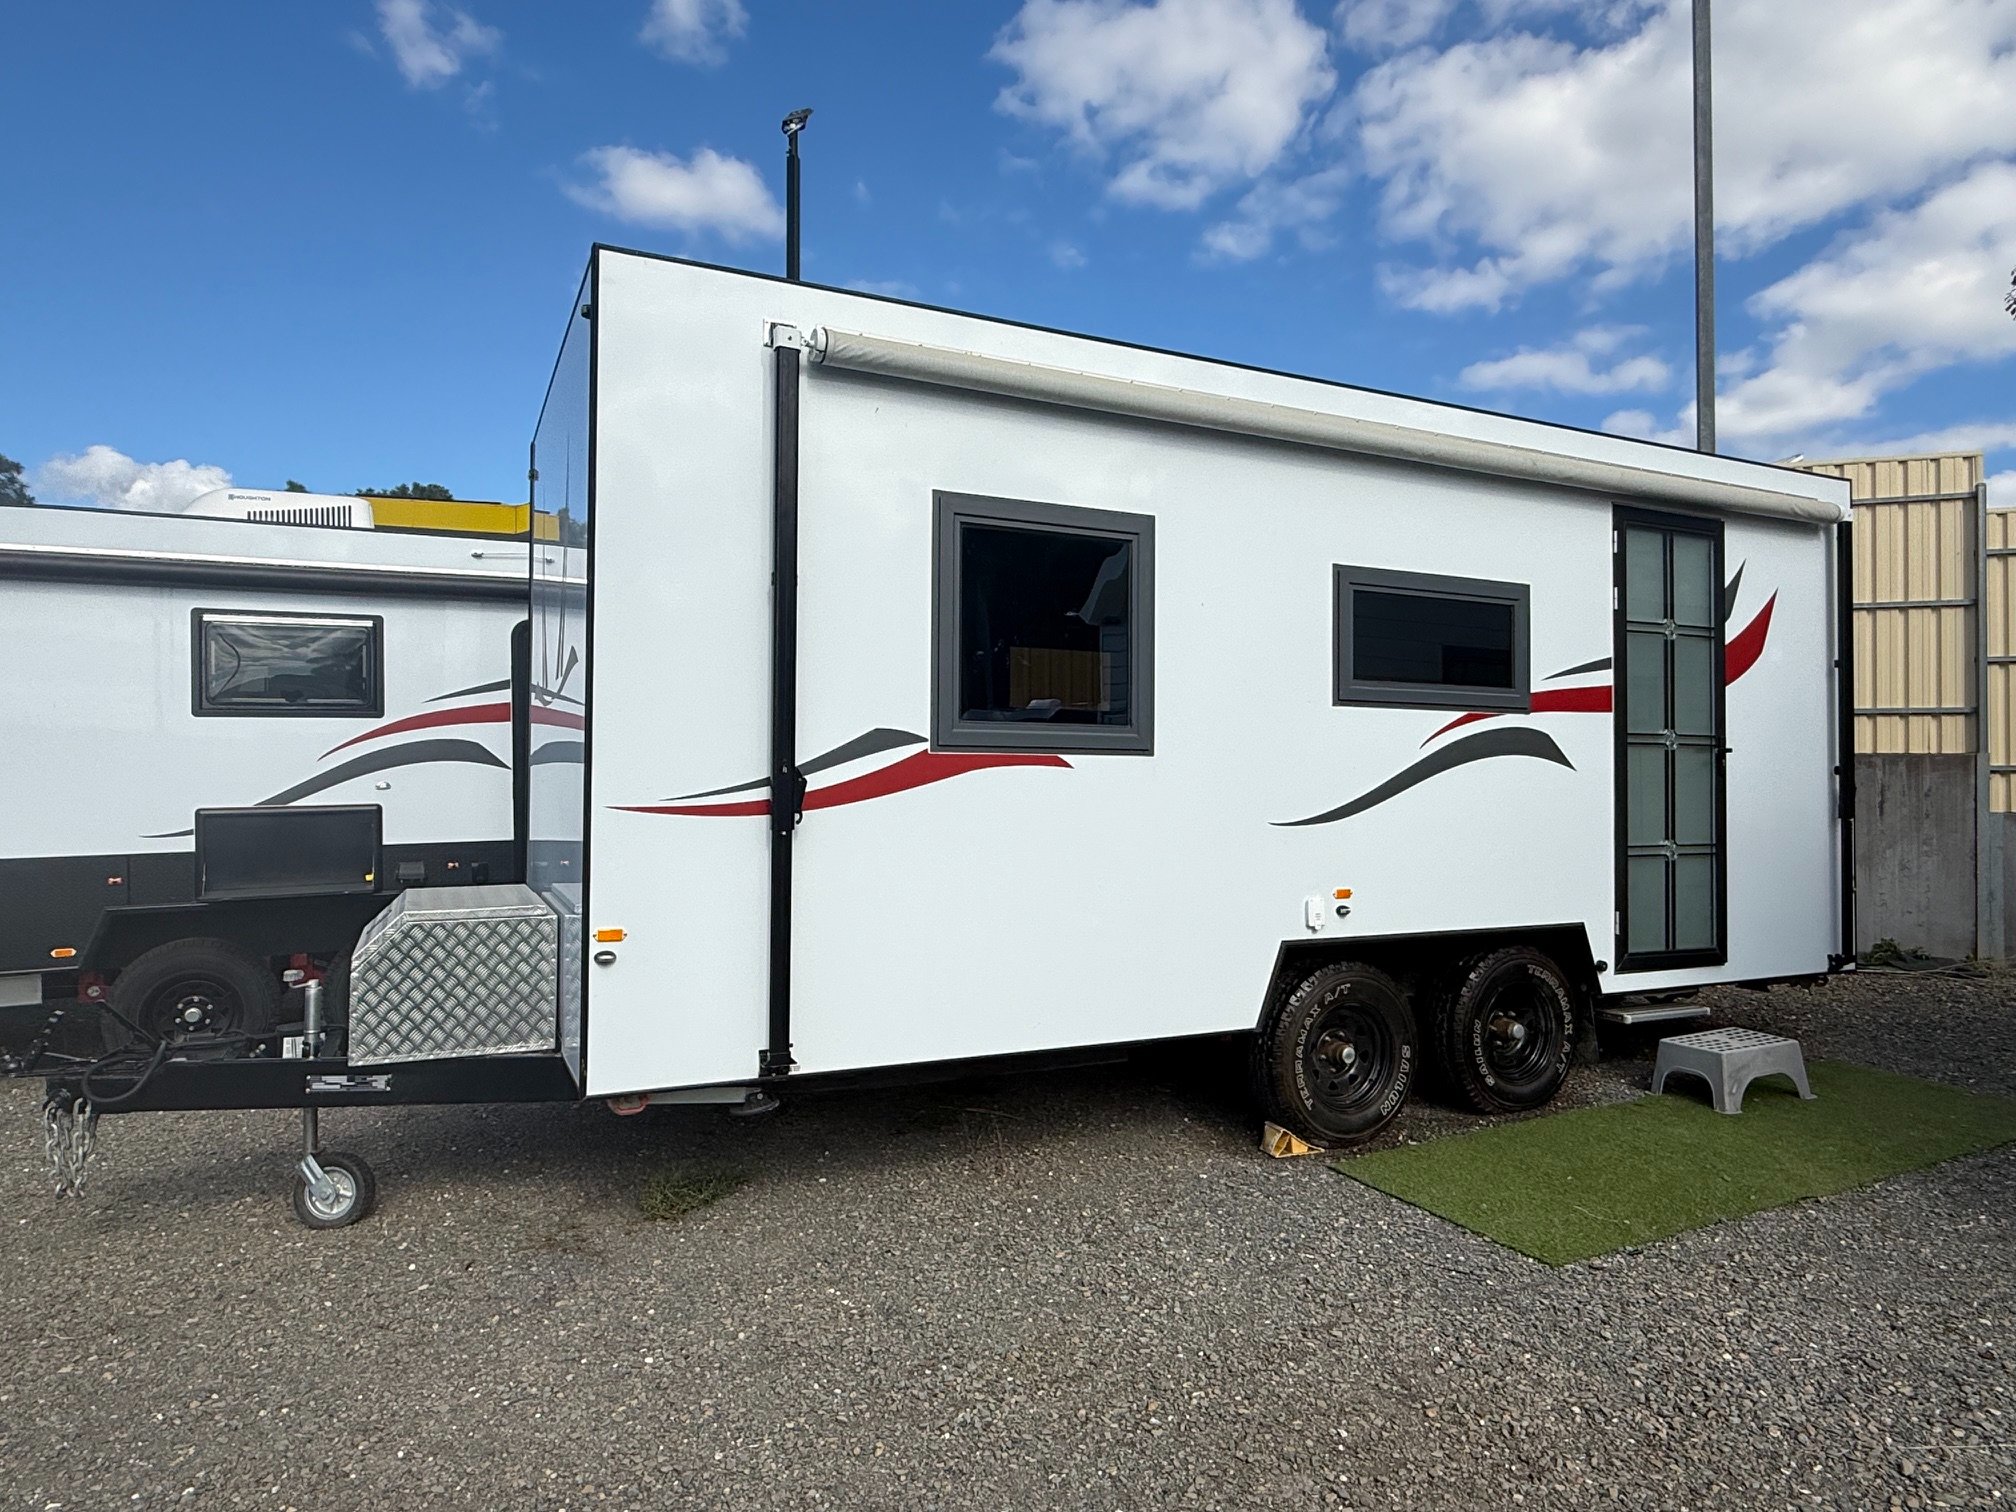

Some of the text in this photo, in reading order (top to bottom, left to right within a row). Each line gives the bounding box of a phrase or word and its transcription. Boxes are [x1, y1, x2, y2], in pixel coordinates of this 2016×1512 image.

[233, 494, 271, 502] HOUGHTON
[1294, 983, 1351, 1111] TERRAMAX A/T
[1473, 1019, 1496, 1087] SAILUN
[1527, 964, 1573, 1074] TERRAMAX A/T
[1380, 1044, 1411, 1116] SAILUN
